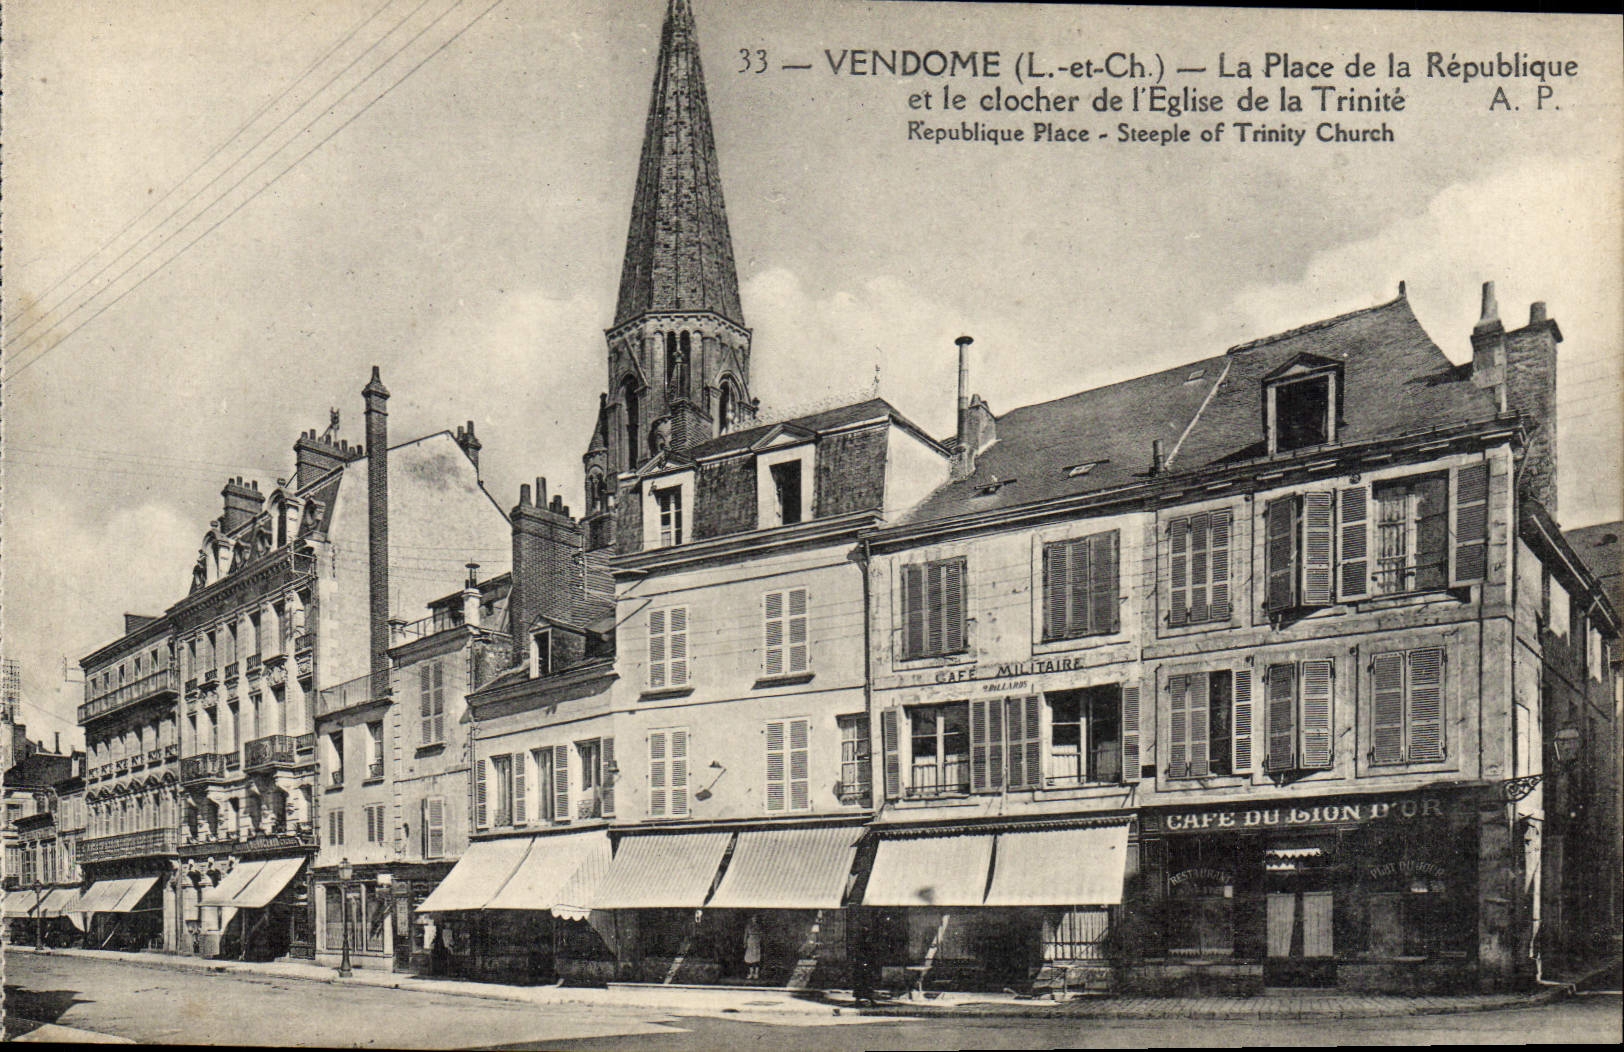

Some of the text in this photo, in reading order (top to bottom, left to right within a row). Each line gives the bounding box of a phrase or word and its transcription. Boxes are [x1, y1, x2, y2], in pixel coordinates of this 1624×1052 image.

[995, 657, 1084, 678] MILITAIRE
[1243, 809, 1280, 827] DU
[1287, 805, 1361, 825] LION
